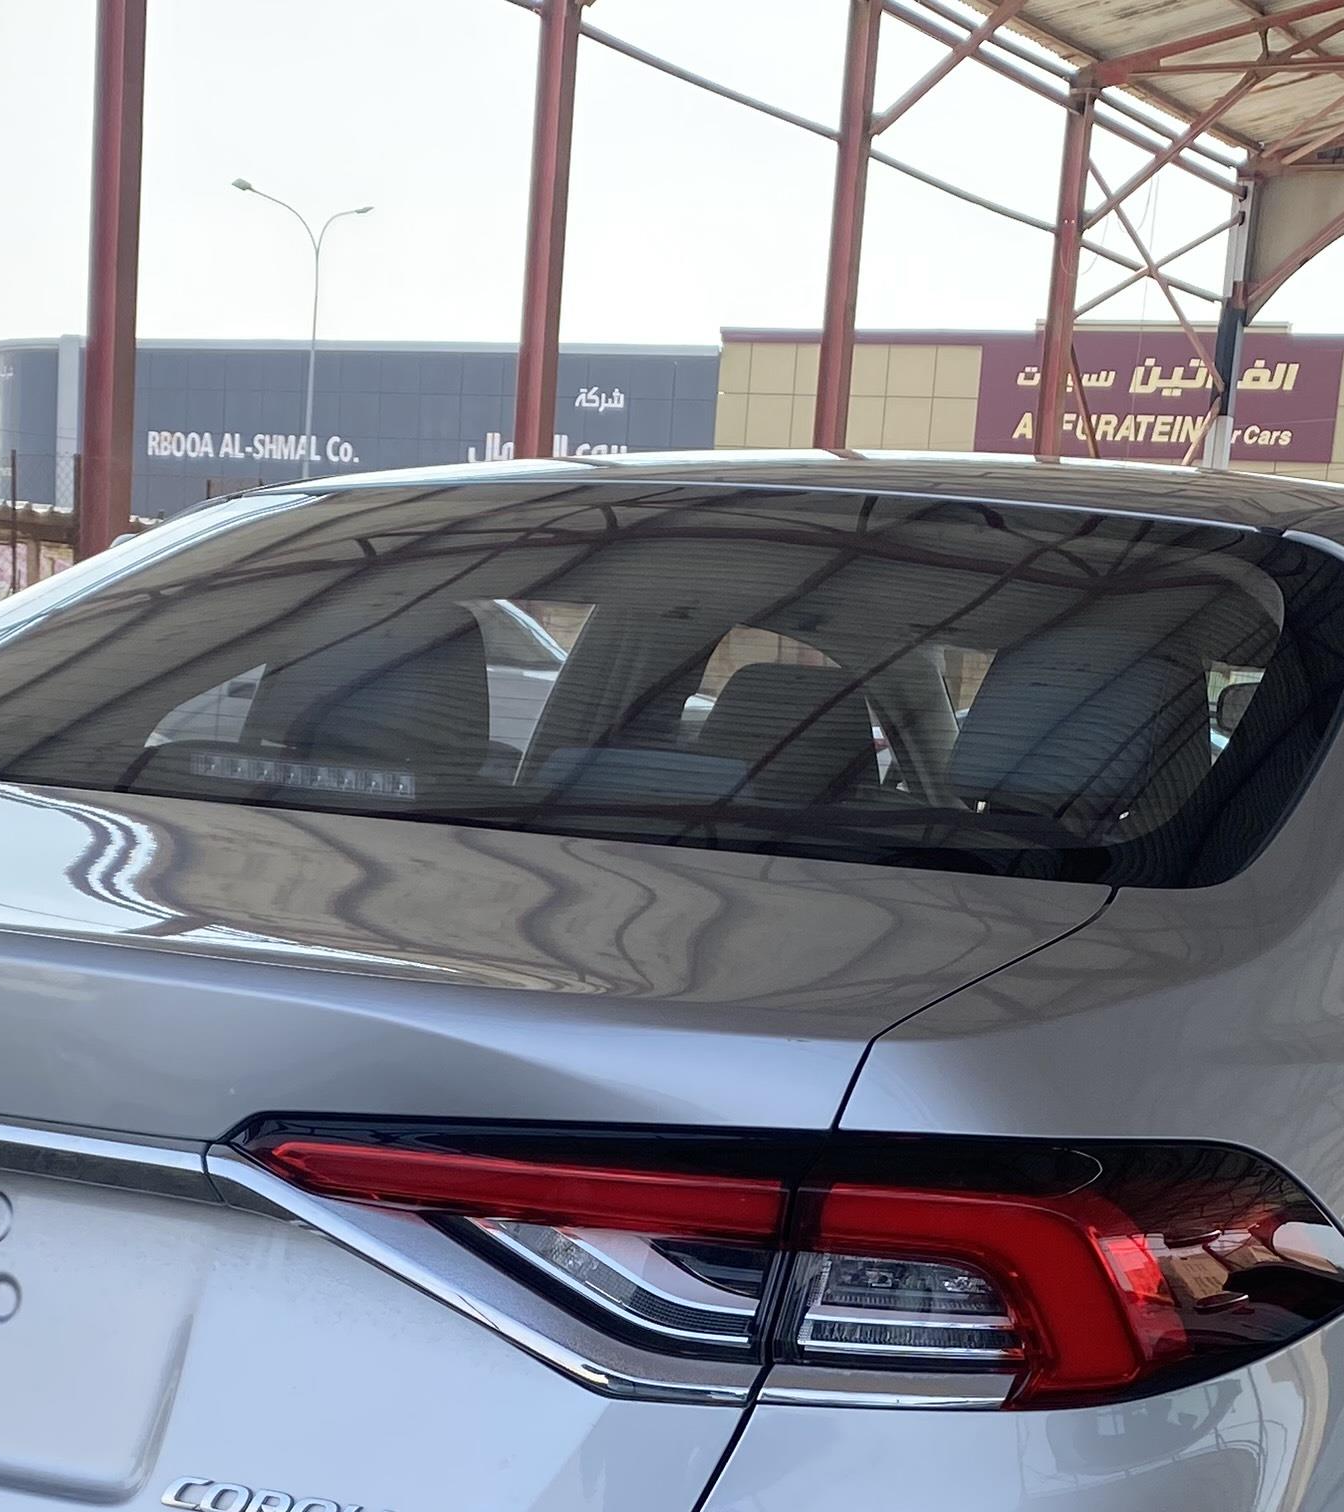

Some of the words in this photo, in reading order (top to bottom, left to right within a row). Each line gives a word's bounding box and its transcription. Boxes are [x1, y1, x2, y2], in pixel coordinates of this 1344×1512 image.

[1129, 357, 1299, 397] الفاتين
[575, 386, 625, 412] شركة
[147, 430, 214, 458] RBOOA
[219, 432, 322, 461] AL-SHMAL
[326, 435, 360, 463] Co.
[1243, 425, 1293, 446] Cars
